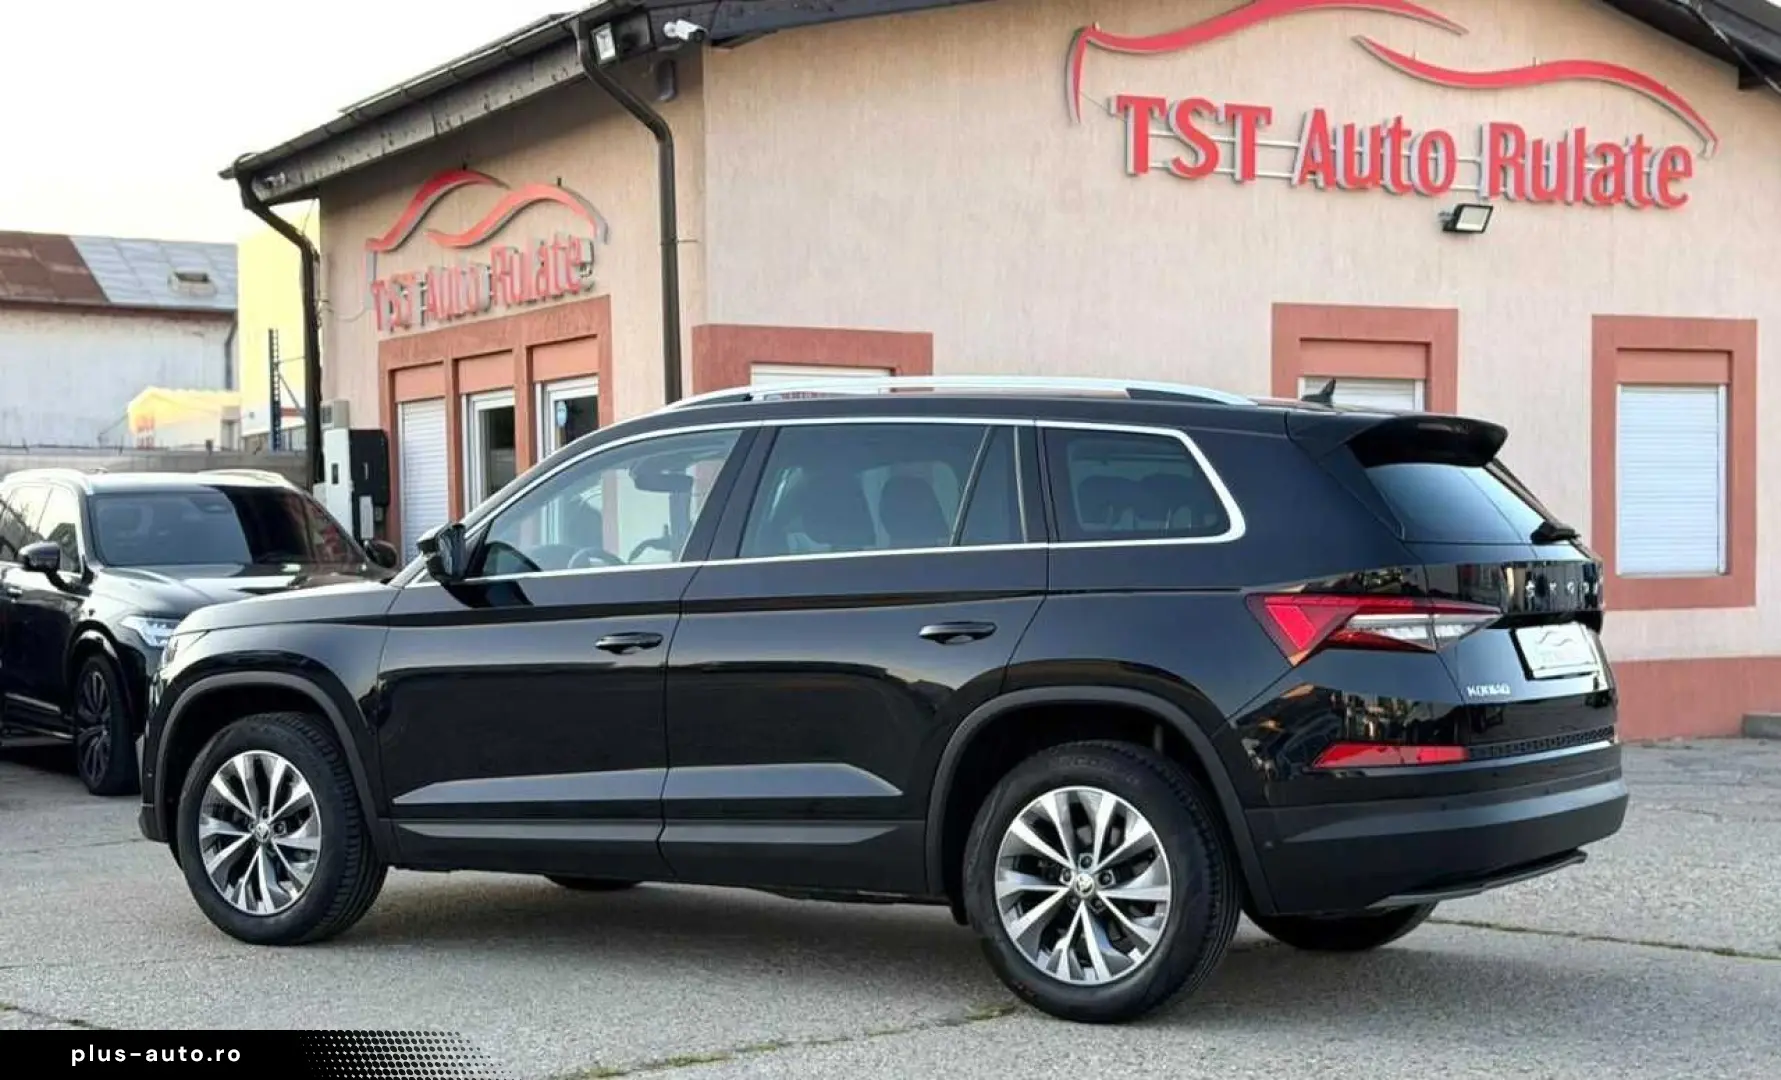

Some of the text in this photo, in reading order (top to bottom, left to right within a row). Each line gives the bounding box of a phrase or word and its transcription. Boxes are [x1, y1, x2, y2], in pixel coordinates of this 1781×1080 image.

[1112, 95, 1695, 209] TST Auto Rulate
[371, 232, 594, 332] TST Auto Rulate
